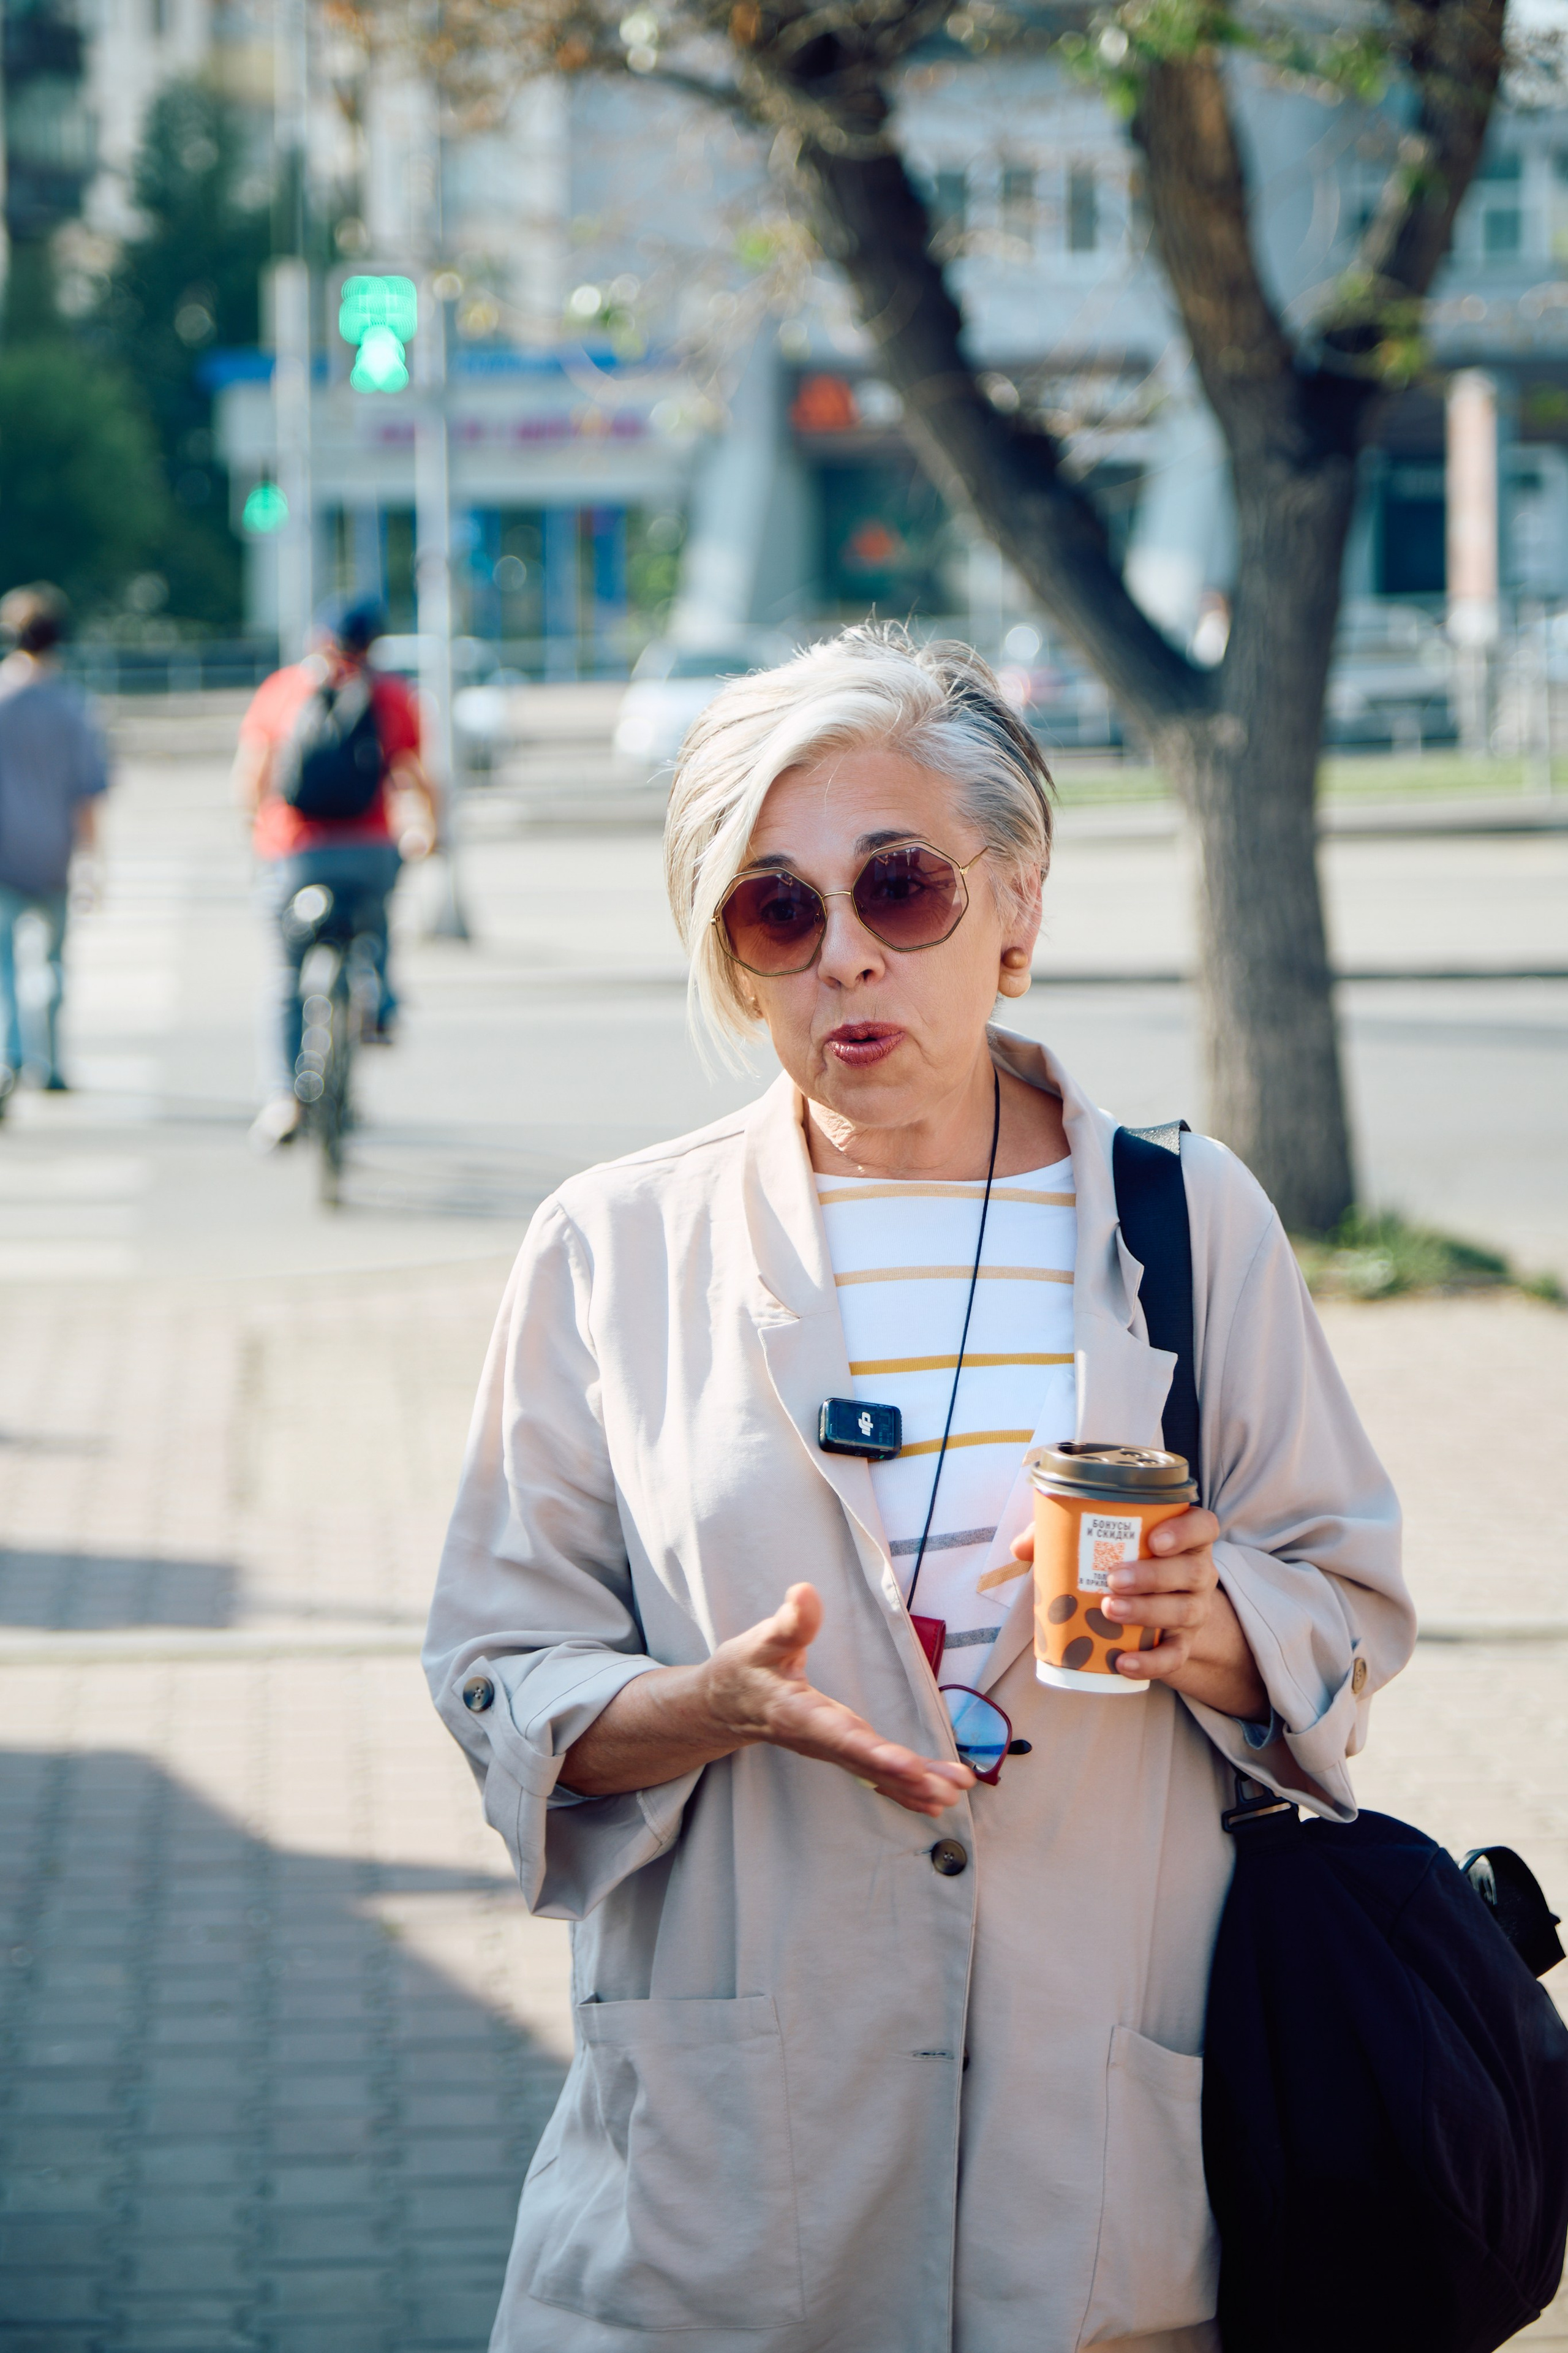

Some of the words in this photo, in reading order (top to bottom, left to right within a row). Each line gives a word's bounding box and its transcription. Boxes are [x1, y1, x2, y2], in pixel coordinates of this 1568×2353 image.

[1093, 1519, 1131, 1530] БОНУСЫ
[1087, 1527, 1093, 1536] И
[1097, 1529, 1135, 1540] СКИДКИ
